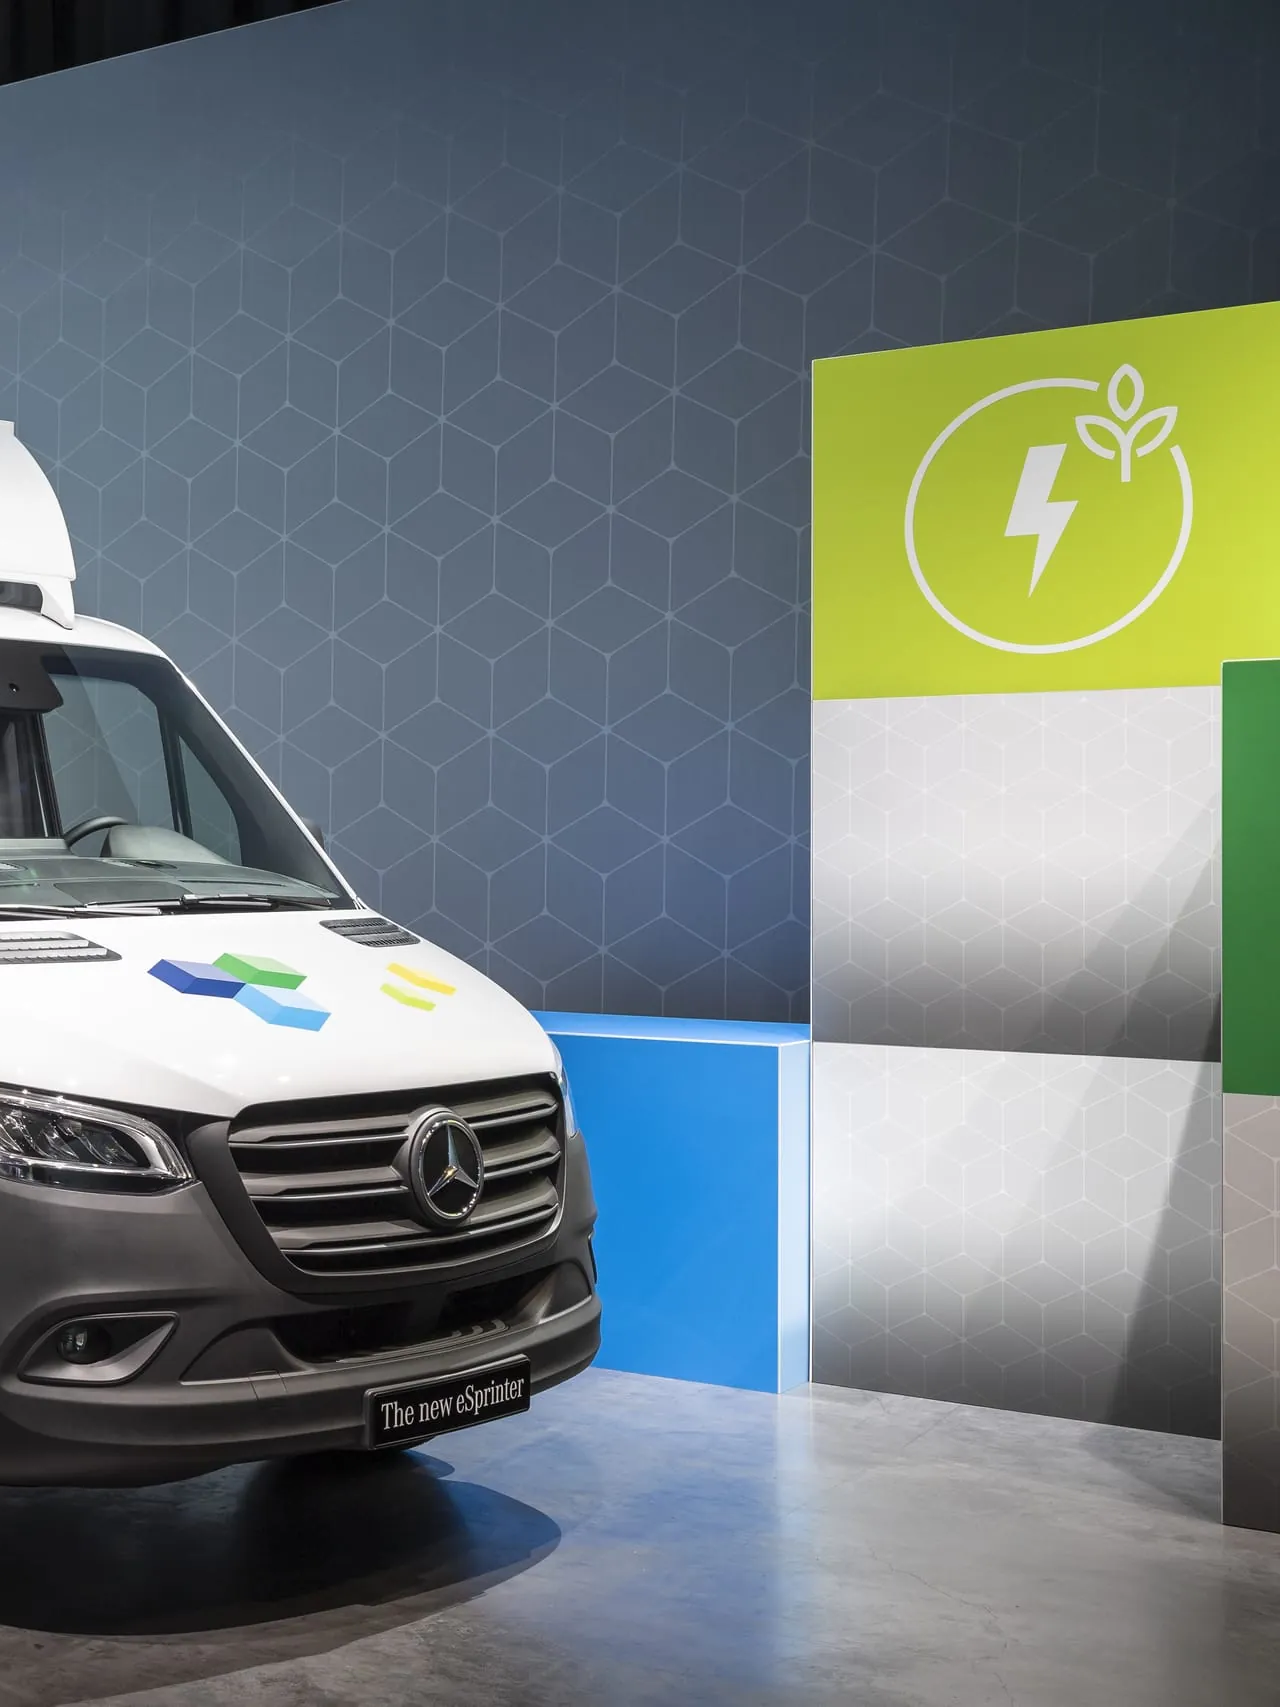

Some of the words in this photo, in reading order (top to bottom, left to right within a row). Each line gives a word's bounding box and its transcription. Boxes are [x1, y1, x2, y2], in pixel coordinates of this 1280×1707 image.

[381, 1401, 415, 1431] The
[419, 1396, 453, 1423] new
[456, 1378, 525, 1416] eSprinter
